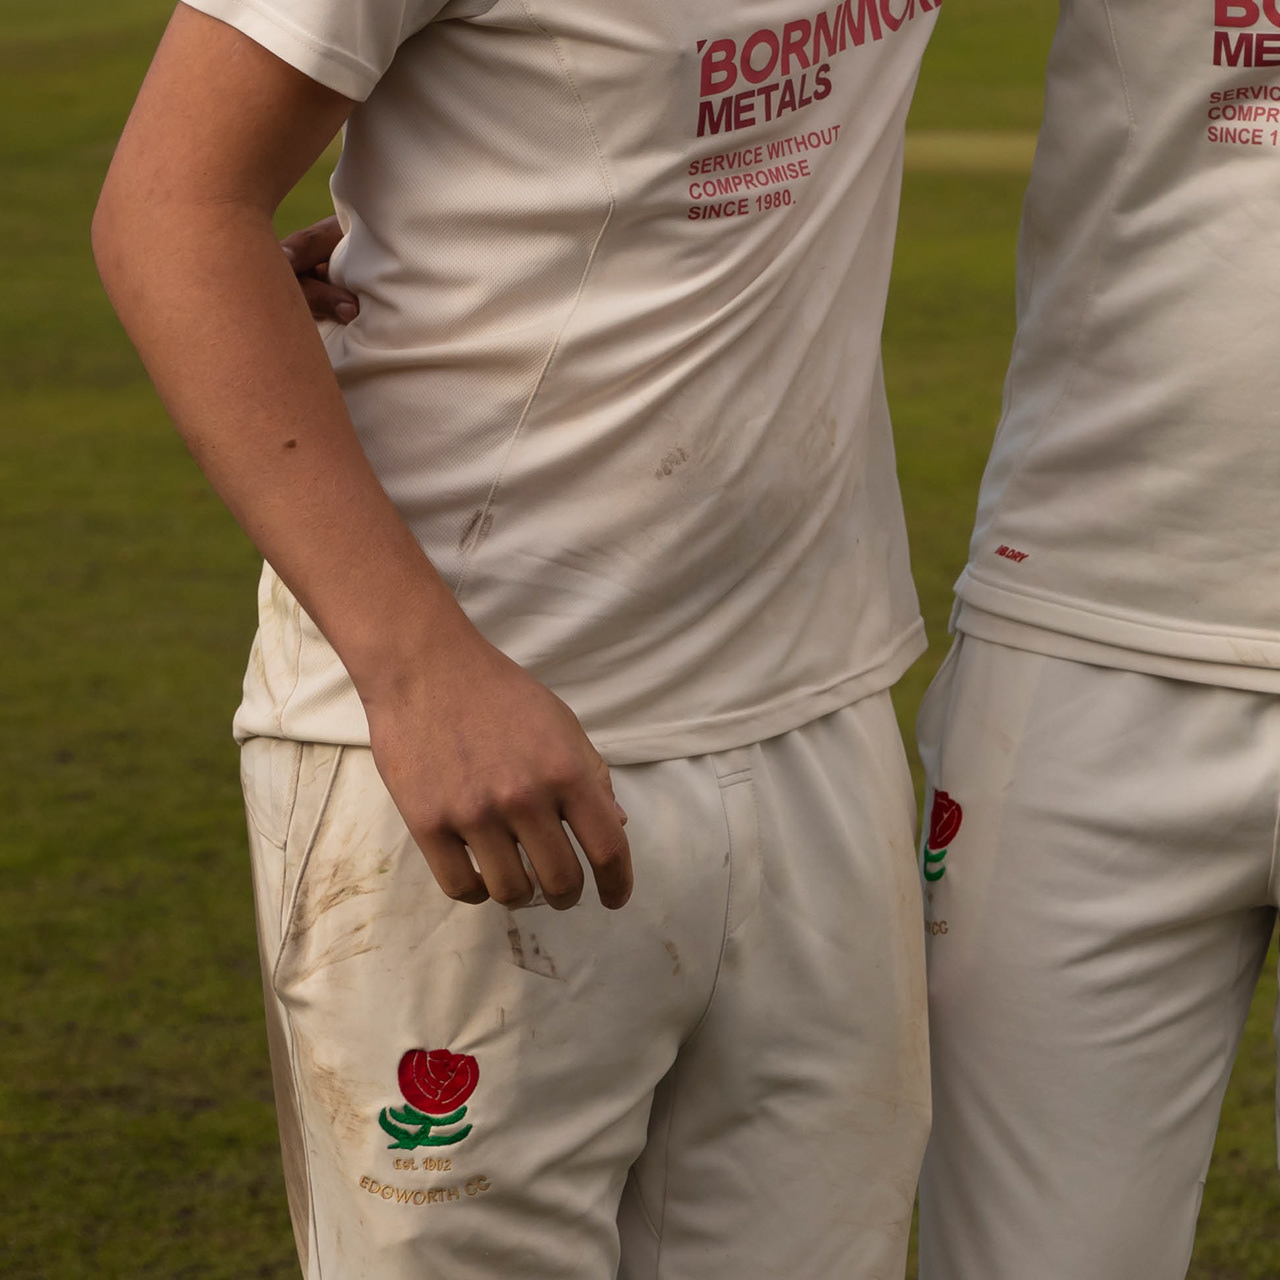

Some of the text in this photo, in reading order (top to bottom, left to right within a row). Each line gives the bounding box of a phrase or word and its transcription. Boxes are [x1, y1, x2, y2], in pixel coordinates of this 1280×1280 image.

[696, 63, 833, 138] METALS
[687, 125, 841, 176] SERVICE WITHOUT
[1207, 125, 1263, 146] SINCE
[688, 159, 811, 200] COMPROMISE
[687, 189, 797, 221] SINCE 1980.
[358, 1175, 491, 1206] EDGWORTH CC
